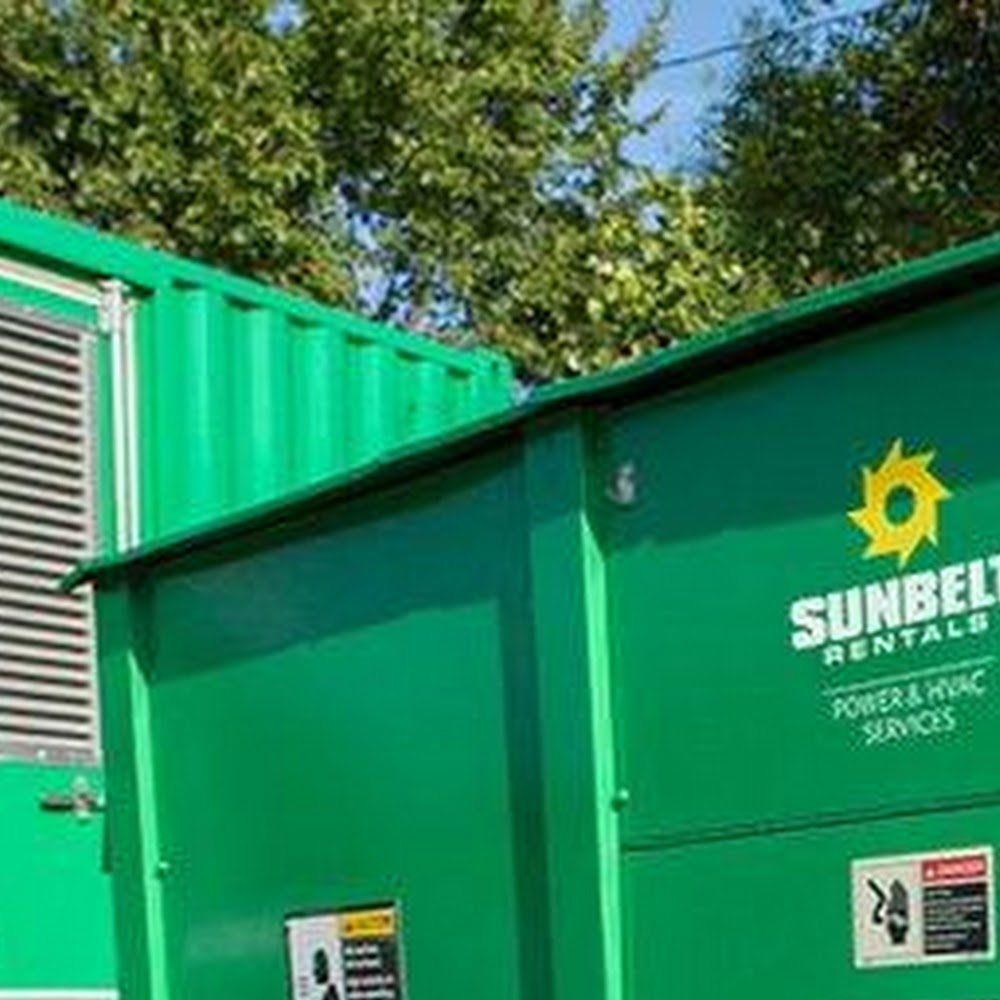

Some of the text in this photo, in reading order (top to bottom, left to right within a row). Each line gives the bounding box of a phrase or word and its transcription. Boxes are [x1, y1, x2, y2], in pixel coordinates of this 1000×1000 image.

[823, 611, 989, 666] RENTALS
[832, 687, 903, 720] POWER
[926, 668, 986, 701] HVAC
[862, 705, 956, 745] SERVICES
